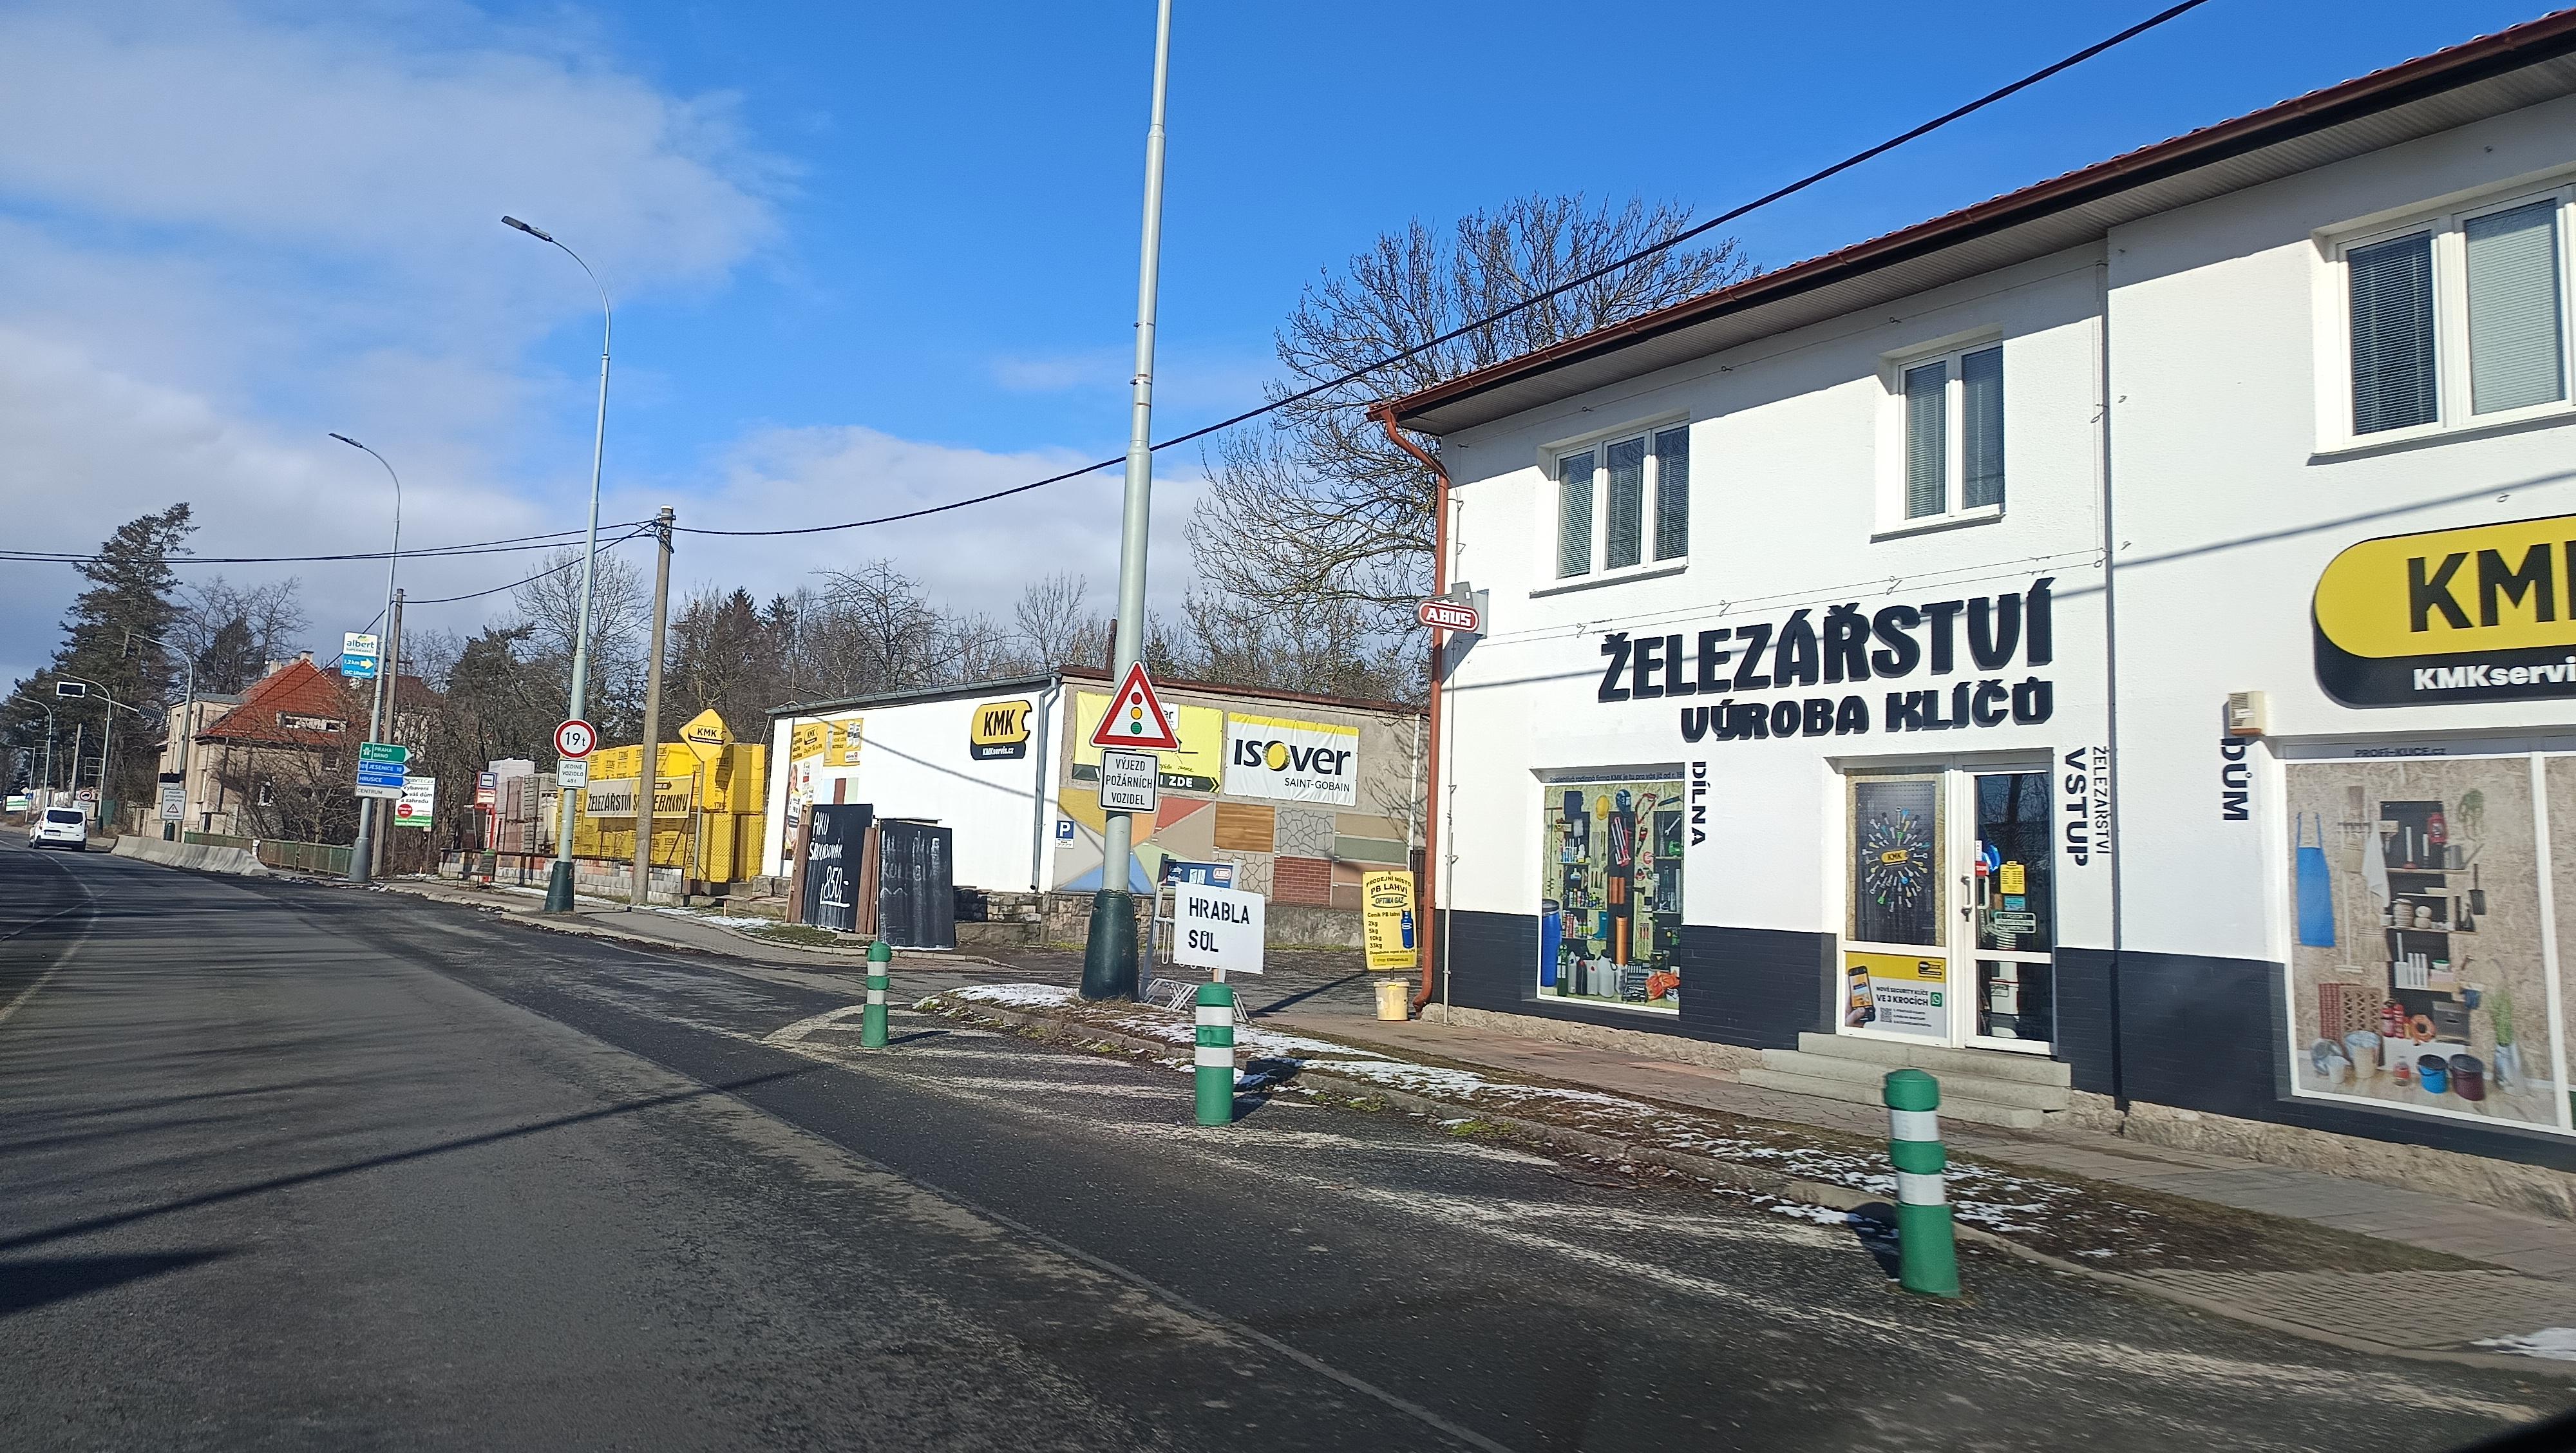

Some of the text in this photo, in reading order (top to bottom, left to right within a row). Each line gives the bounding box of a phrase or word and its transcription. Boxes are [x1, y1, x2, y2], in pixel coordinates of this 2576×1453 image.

[2407, 540, 2576, 632] KM
[1426, 607, 1471, 627] ABUS
[346, 640, 375, 649] albert
[1598, 577, 2056, 703] ŽELEZÁŘSTVÍ
[2414, 656, 2576, 690] KMKservi
[1681, 676, 2054, 743] VÝROBA KLÍČŮ
[697, 727, 717, 737] KMK
[983, 709, 1016, 737] KMK
[982, 745, 1014, 755] KMKservis.cz
[1115, 756, 1146, 772] VÝJEZD
[1105, 773, 1153, 789] POŽÁRNÍCH
[1169, 776, 1193, 788] ZDE
[1285, 777, 1350, 792] SAINT-GOBAIN
[2221, 737, 2253, 821] DŮM
[587, 792, 689, 812] ŽELEZÁŘSTVÍ SEBNINY
[1112, 792, 1146, 806] VOZIDEL
[1691, 761, 1711, 847] DÍLNA
[2065, 746, 2088, 866] VSTUP
[812, 811, 829, 837] AKU
[1059, 821, 1071, 837] P
[1366, 876, 1412, 888] PRODEJNÍ MÍSTO
[1370, 886, 1381, 895] PB
[1189, 897, 1250, 925] HRABLA
[1188, 929, 1219, 953] SŮL
[1893, 996, 1929, 1007] KROCÍCH
